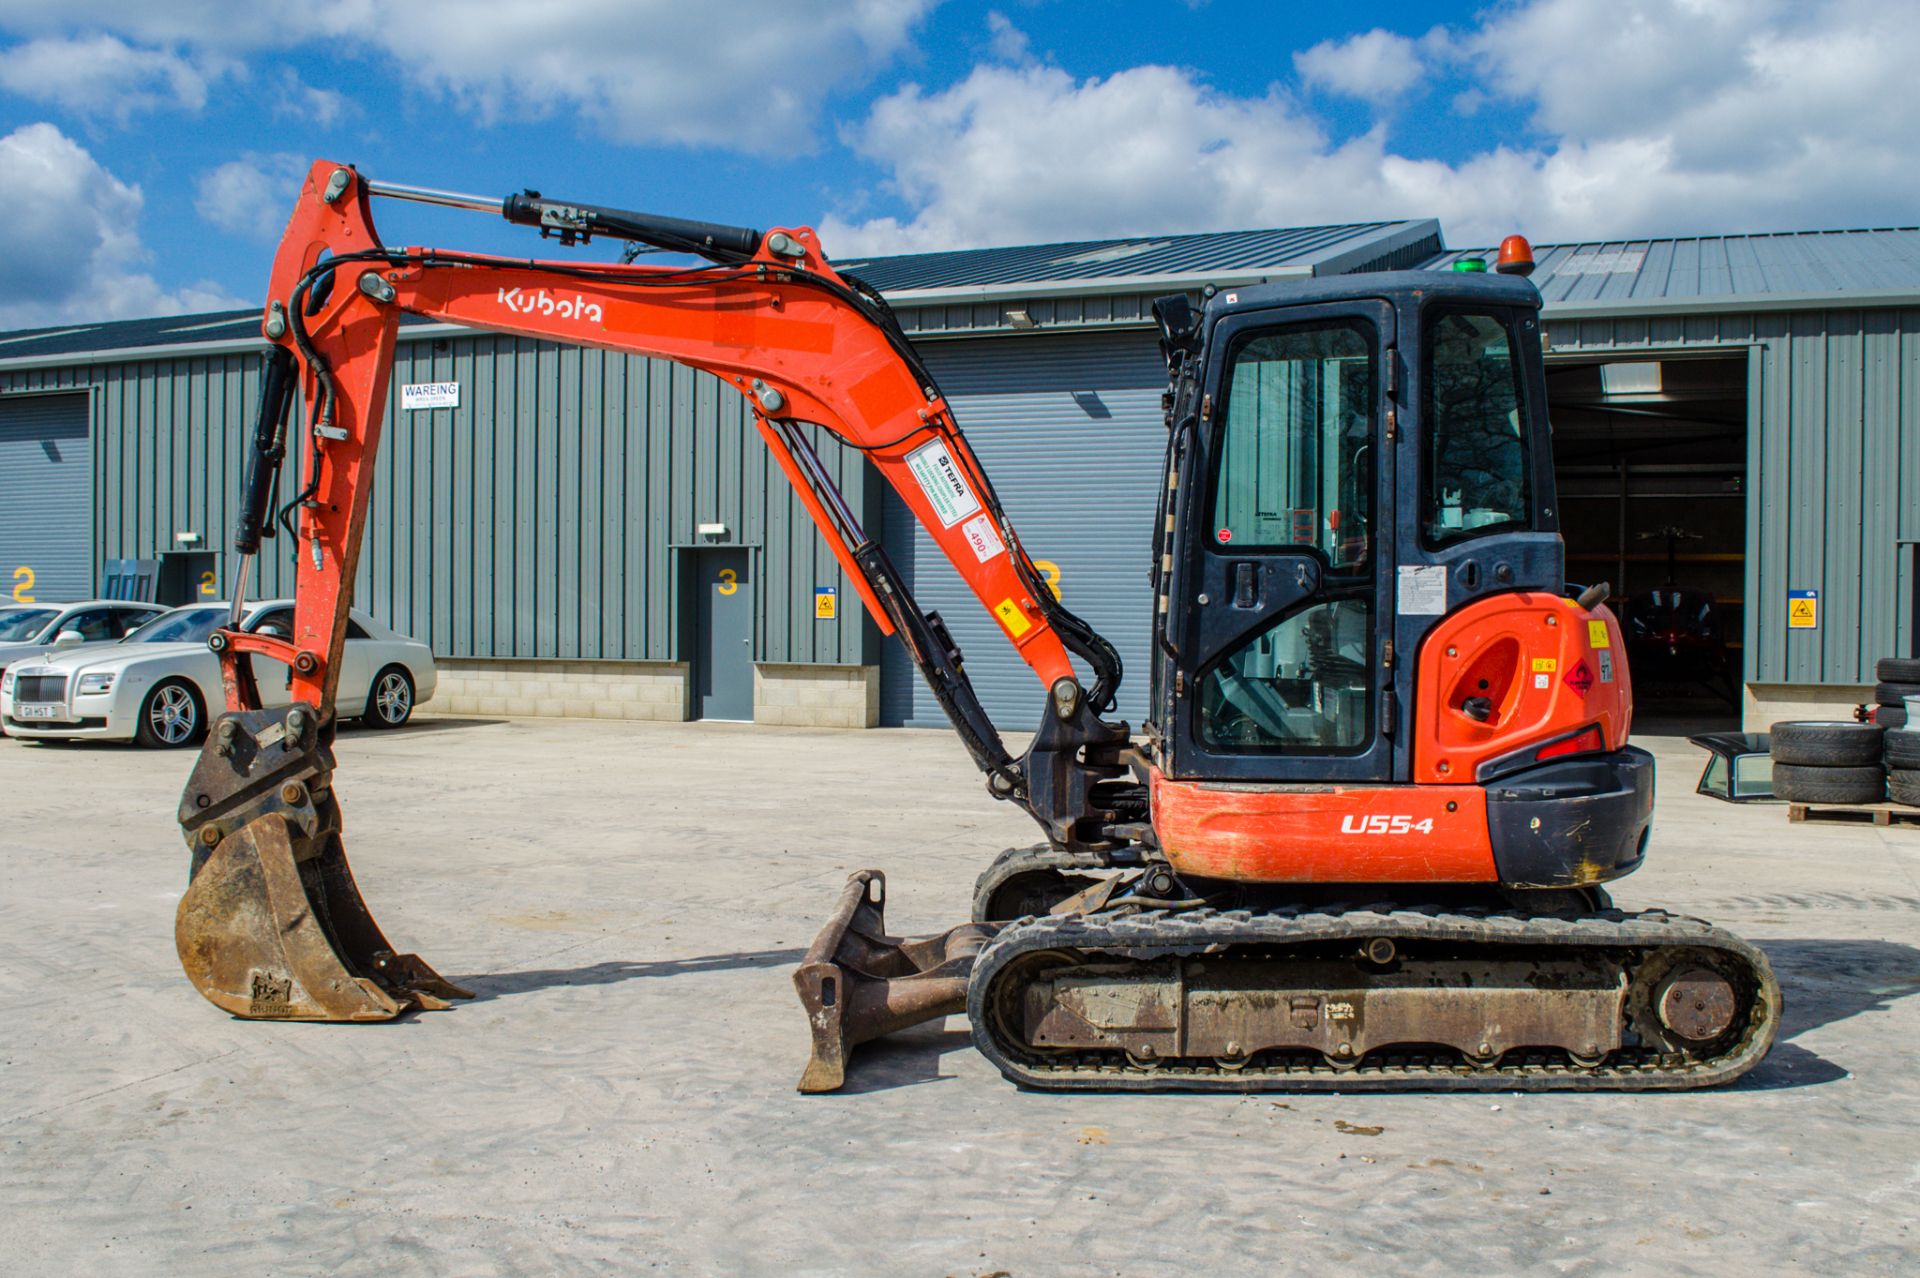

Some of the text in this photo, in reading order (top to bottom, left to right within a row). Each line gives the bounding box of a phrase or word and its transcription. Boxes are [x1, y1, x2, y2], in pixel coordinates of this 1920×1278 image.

[497, 287, 602, 322] Kubota
[405, 384, 457, 397] WAREING
[944, 467, 965, 497] TEFRA
[970, 531, 986, 553] 490
[13, 566, 35, 603] 2
[201, 571, 216, 594] 2
[718, 568, 738, 595] 3
[1341, 815, 1433, 834] U55-4
